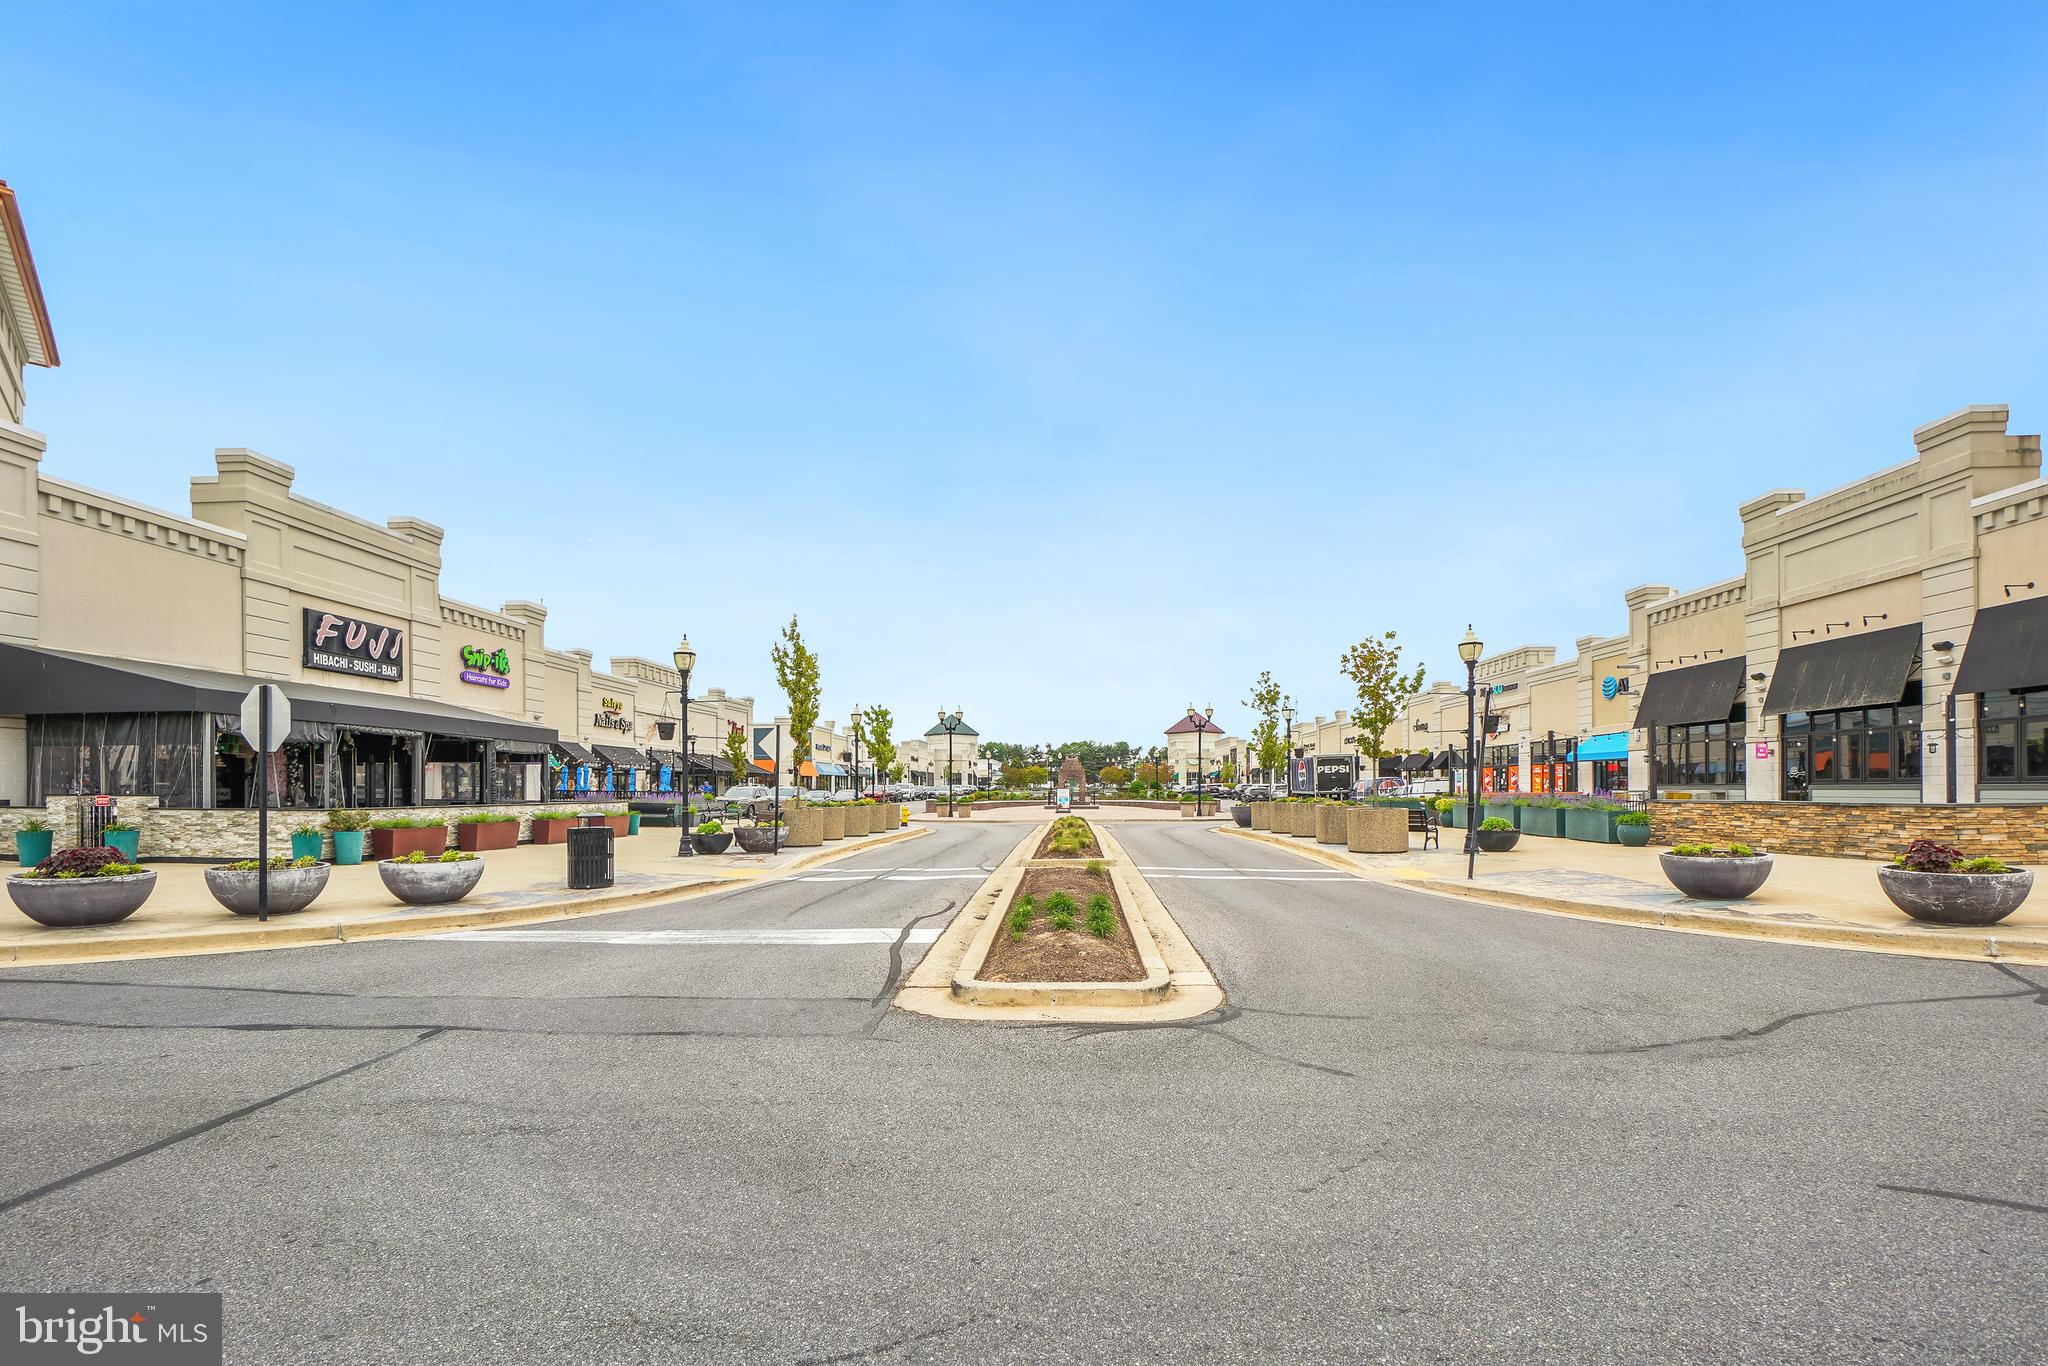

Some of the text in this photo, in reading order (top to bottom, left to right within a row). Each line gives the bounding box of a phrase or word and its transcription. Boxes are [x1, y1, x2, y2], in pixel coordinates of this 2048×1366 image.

[315, 614, 403, 660] FUJI
[313, 652, 348, 669] HIBACHI
[353, 659, 377, 674] SUSHI
[382, 664, 398, 677] BAR
[466, 672, 507, 687] Haircuts for Kids
[594, 713, 614, 729] Nails
[1317, 765, 1350, 774] PEPSI
